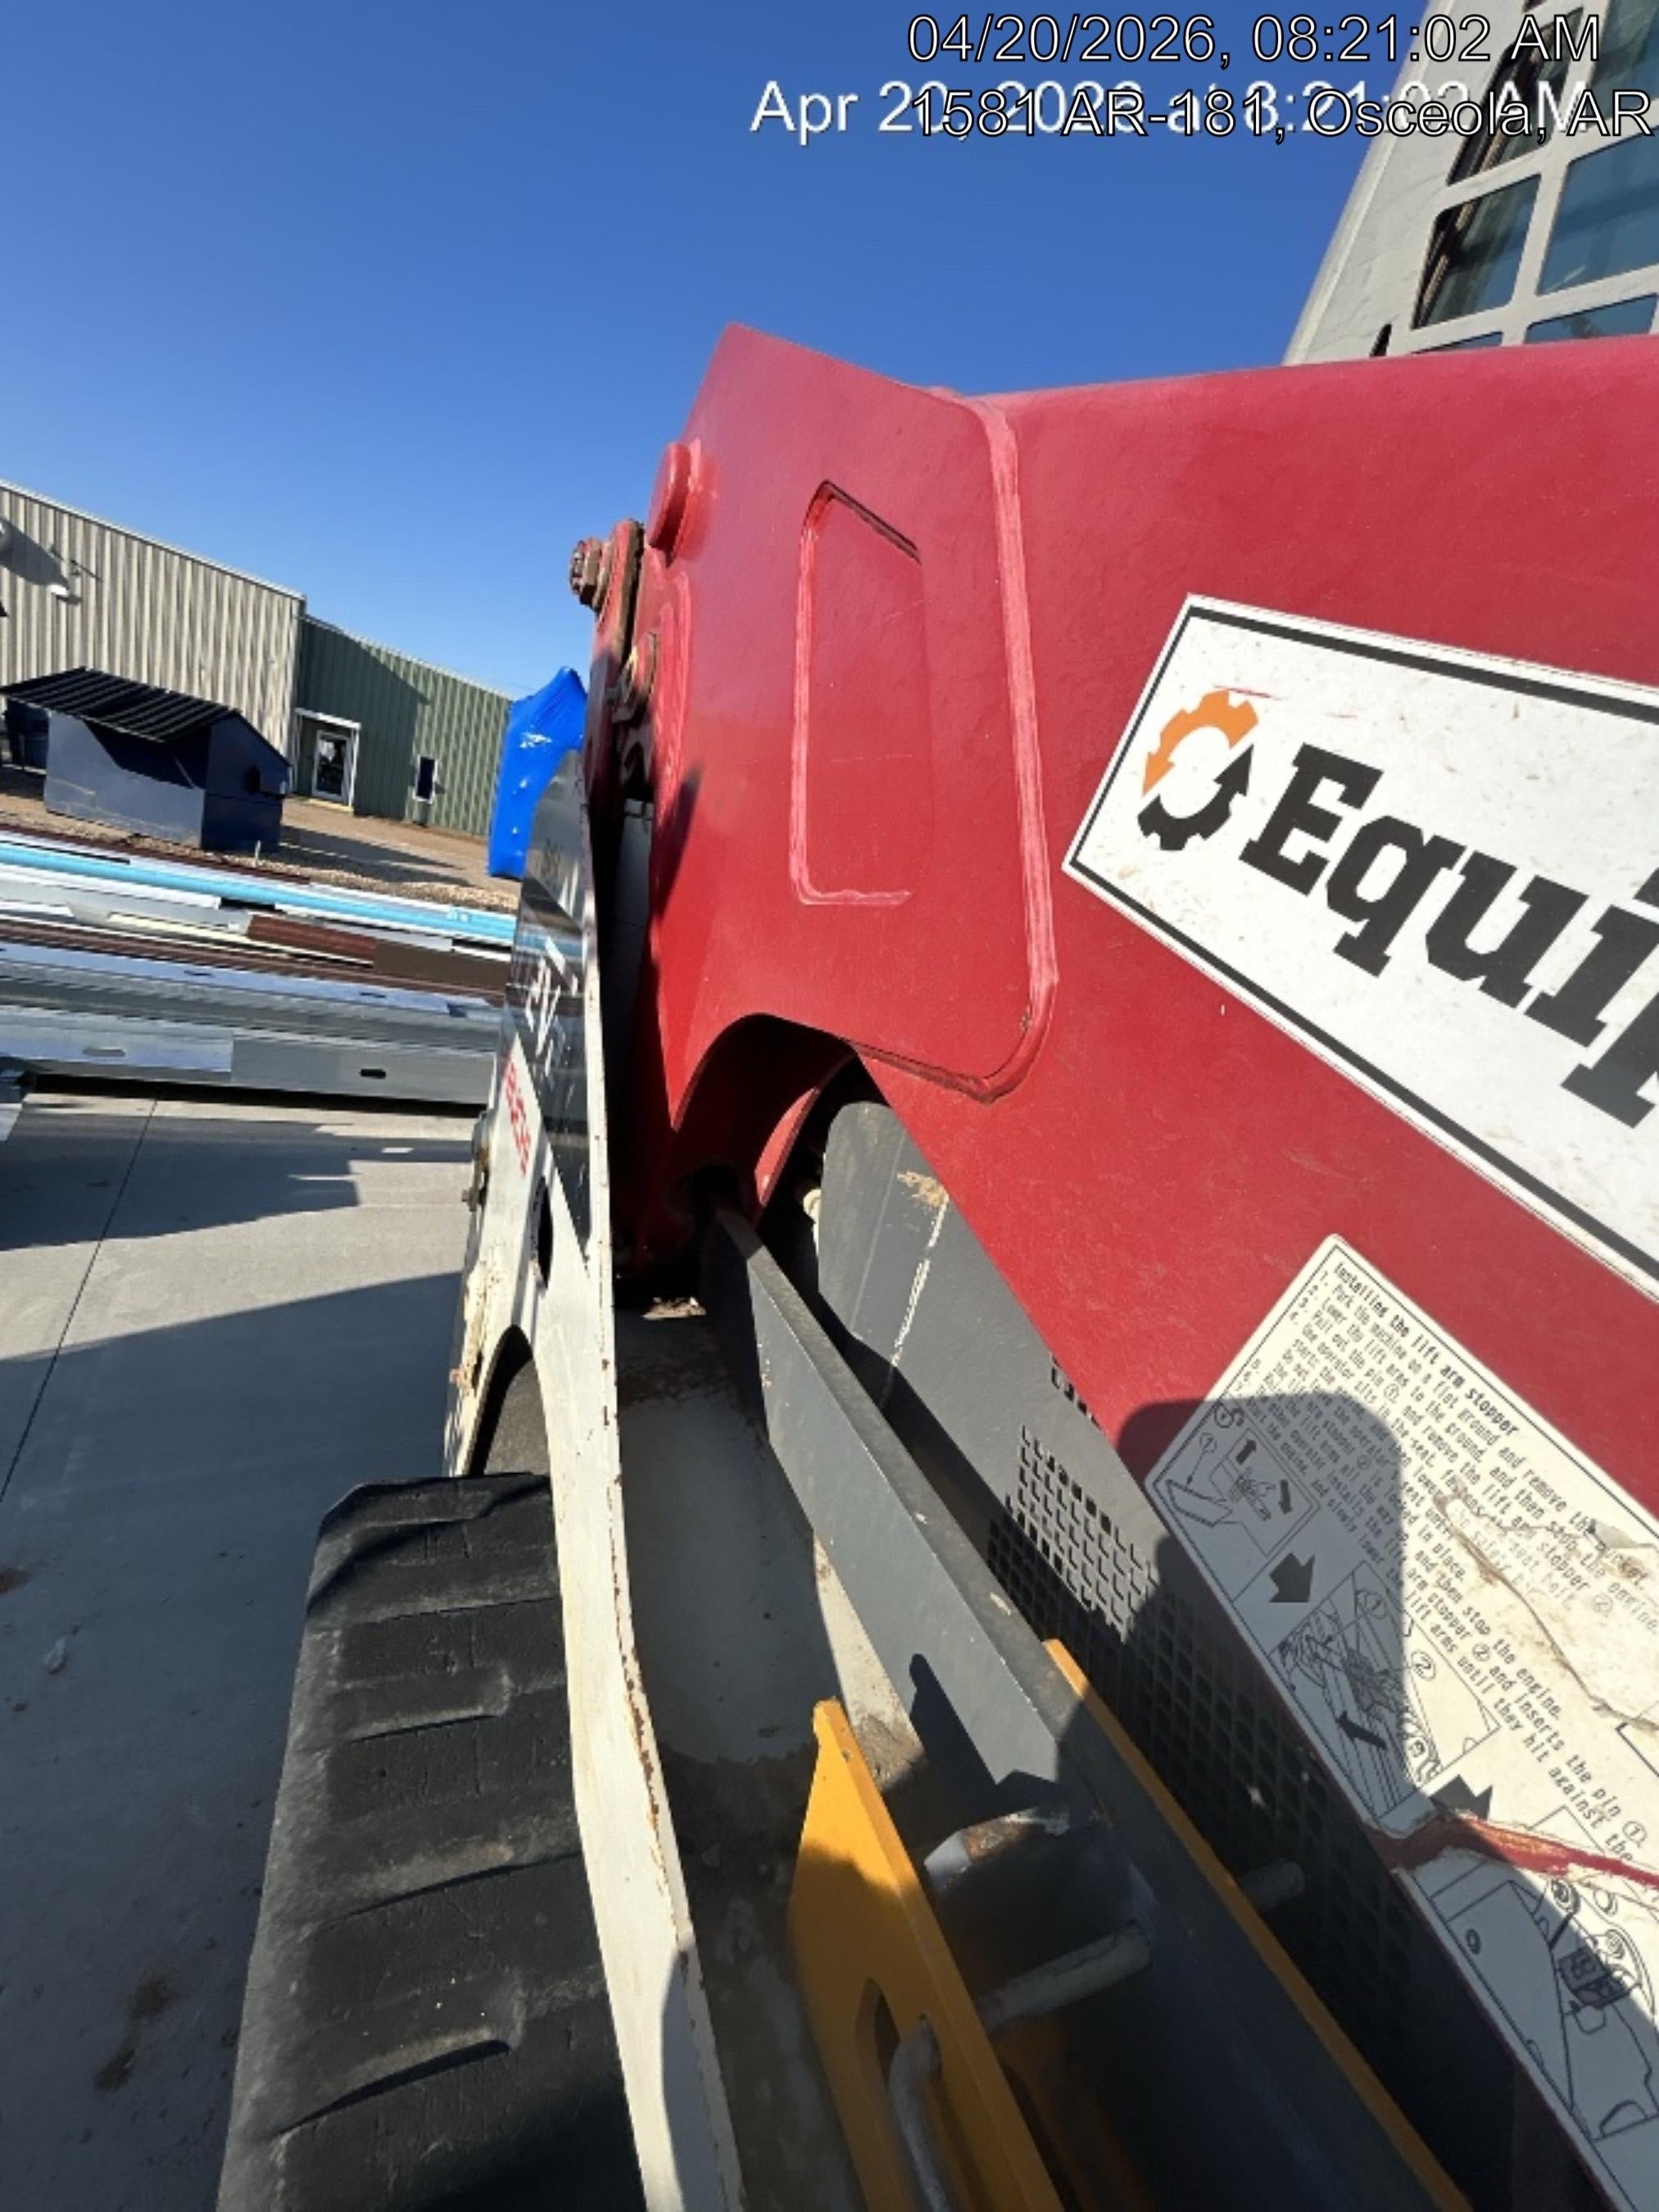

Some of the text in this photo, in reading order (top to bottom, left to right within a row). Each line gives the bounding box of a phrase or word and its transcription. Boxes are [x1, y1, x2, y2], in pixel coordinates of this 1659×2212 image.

[1311, 1308, 1333, 1334] Pull
[1330, 1333, 1349, 1353] out
[1348, 1348, 1365, 1370] the
[1362, 1367, 1385, 1387] pin
[1402, 1404, 1424, 1426] and
[1421, 1424, 1458, 1463] remove
[1458, 1461, 1481, 1485] the
[1481, 1483, 1512, 1515] lift
[1535, 1542, 1590, 1591] stopper
[1318, 1365, 1335, 1385] the
[1387, 1439, 1412, 1467] then
[1321, 1296, 1348, 1324] Lower
[1346, 1322, 1364, 1343] the
[1363, 1338, 1387, 1365] lift
[1385, 1362, 1409, 1387] arms
[1409, 1385, 1425, 1402] to
[1424, 1399, 1445, 1423] the
[1488, 1466, 1517, 1489] and
[1513, 1488, 1545, 1520] then
[1331, 1283, 1353, 1308] Park
[1353, 1304, 1370, 1326] the
[1432, 1380, 1458, 1409] flat
[1456, 1407, 1500, 1446] ground
[1497, 1446, 1527, 1469] and
[1522, 1468, 1567, 1512] remove
[1333, 1262, 1519, 1436] Installing the lift arm stopper
[1378, 1404, 1389, 1419] in
[1390, 1416, 1409, 1439] the
[1358, 1483, 1376, 1505] the
[1414, 1549, 1439, 1573] and
[1435, 1571, 1463, 1604] then
[1462, 1606, 1491, 1636] stop
[1492, 1638, 1516, 1665] the
[1516, 1667, 1562, 1720] engine.
[1416, 1523, 1433, 1543] in
[1363, 1515, 1382, 1539] the
[1407, 1567, 1429, 1591] arm
[1427, 1592, 1472, 1639] stopper
[1488, 1665, 1517, 1692] and
[1513, 1693, 1565, 1751] inserts
[1565, 1753, 1592, 1783] the
[1590, 1787, 1621, 1817] pin
[1404, 1589, 1431, 1620] lift
[1429, 1623, 1458, 1653] arms
[1457, 1655, 1495, 1694] until
[1493, 1697, 1523, 1731] they
[1521, 1732, 1549, 1763] hit
[1548, 1766, 1609, 1829] against
[1604, 1832, 1633, 1861] the
